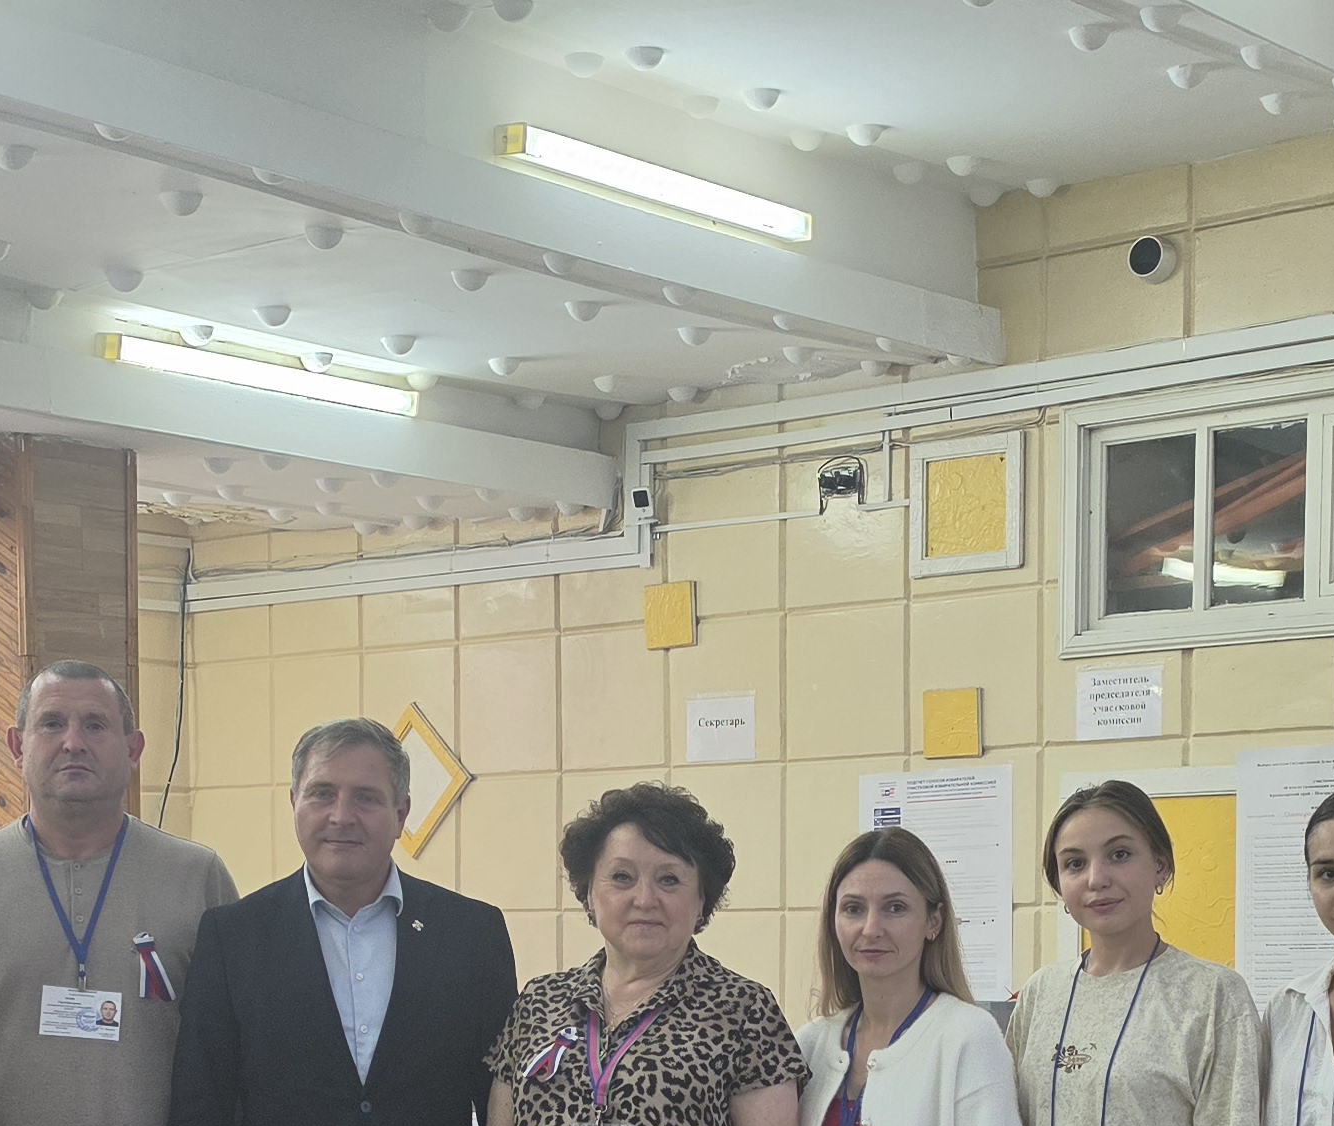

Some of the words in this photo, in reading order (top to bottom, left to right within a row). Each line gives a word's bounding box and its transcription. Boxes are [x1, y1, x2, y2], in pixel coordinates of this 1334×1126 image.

[1091, 676, 1150, 687] Заместитель
[1089, 689, 1151, 702] председателя
[1093, 701, 1146, 715] участковой
[698, 717, 746, 729] Секретарь
[1097, 717, 1142, 727] комиссии
